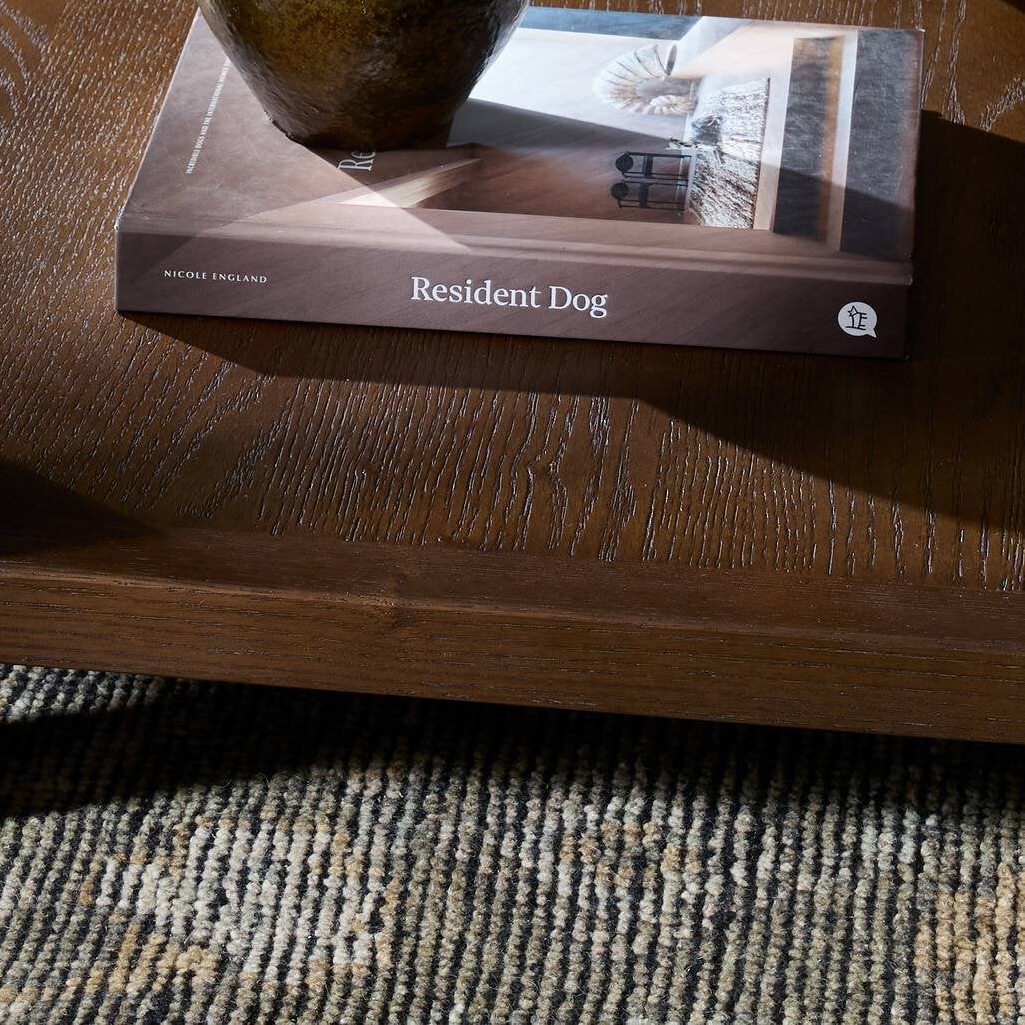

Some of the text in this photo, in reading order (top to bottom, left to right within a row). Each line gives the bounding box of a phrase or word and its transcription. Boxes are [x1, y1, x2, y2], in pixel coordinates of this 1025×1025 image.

[164, 270, 267, 284] NICOLE ENGLAND
[411, 276, 608, 319] Resident Dog
